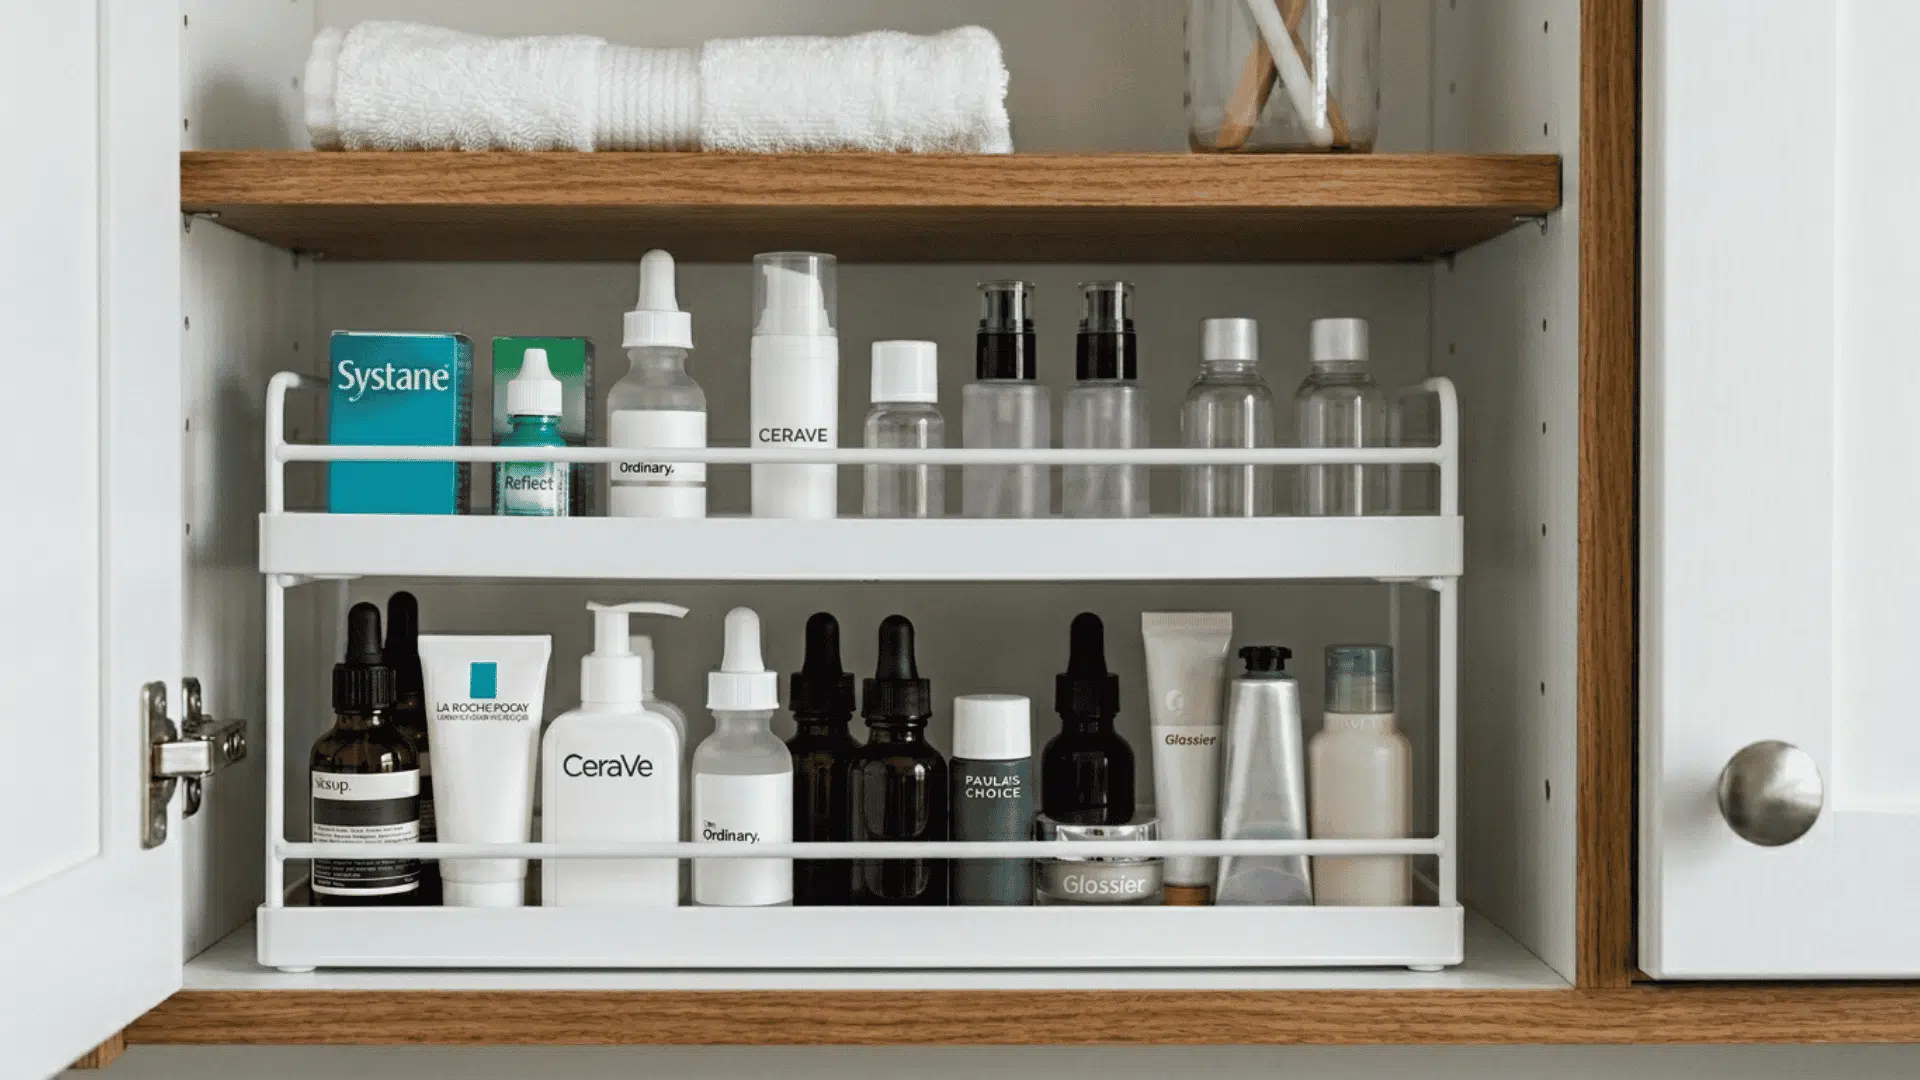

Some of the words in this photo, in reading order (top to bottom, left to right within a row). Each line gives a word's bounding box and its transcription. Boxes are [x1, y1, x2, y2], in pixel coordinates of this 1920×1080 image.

[337, 359, 449, 402] Systane
[758, 427, 828, 443] CERAVE
[619, 461, 675, 477] Ordinary.
[436, 702, 449, 713] LA
[452, 702, 493, 714] ROCHE
[563, 753, 653, 777] CeraVe
[965, 787, 1021, 799] CHOICE
[703, 828, 760, 844] Ordinary.
[1063, 875, 1147, 894] Glossier
